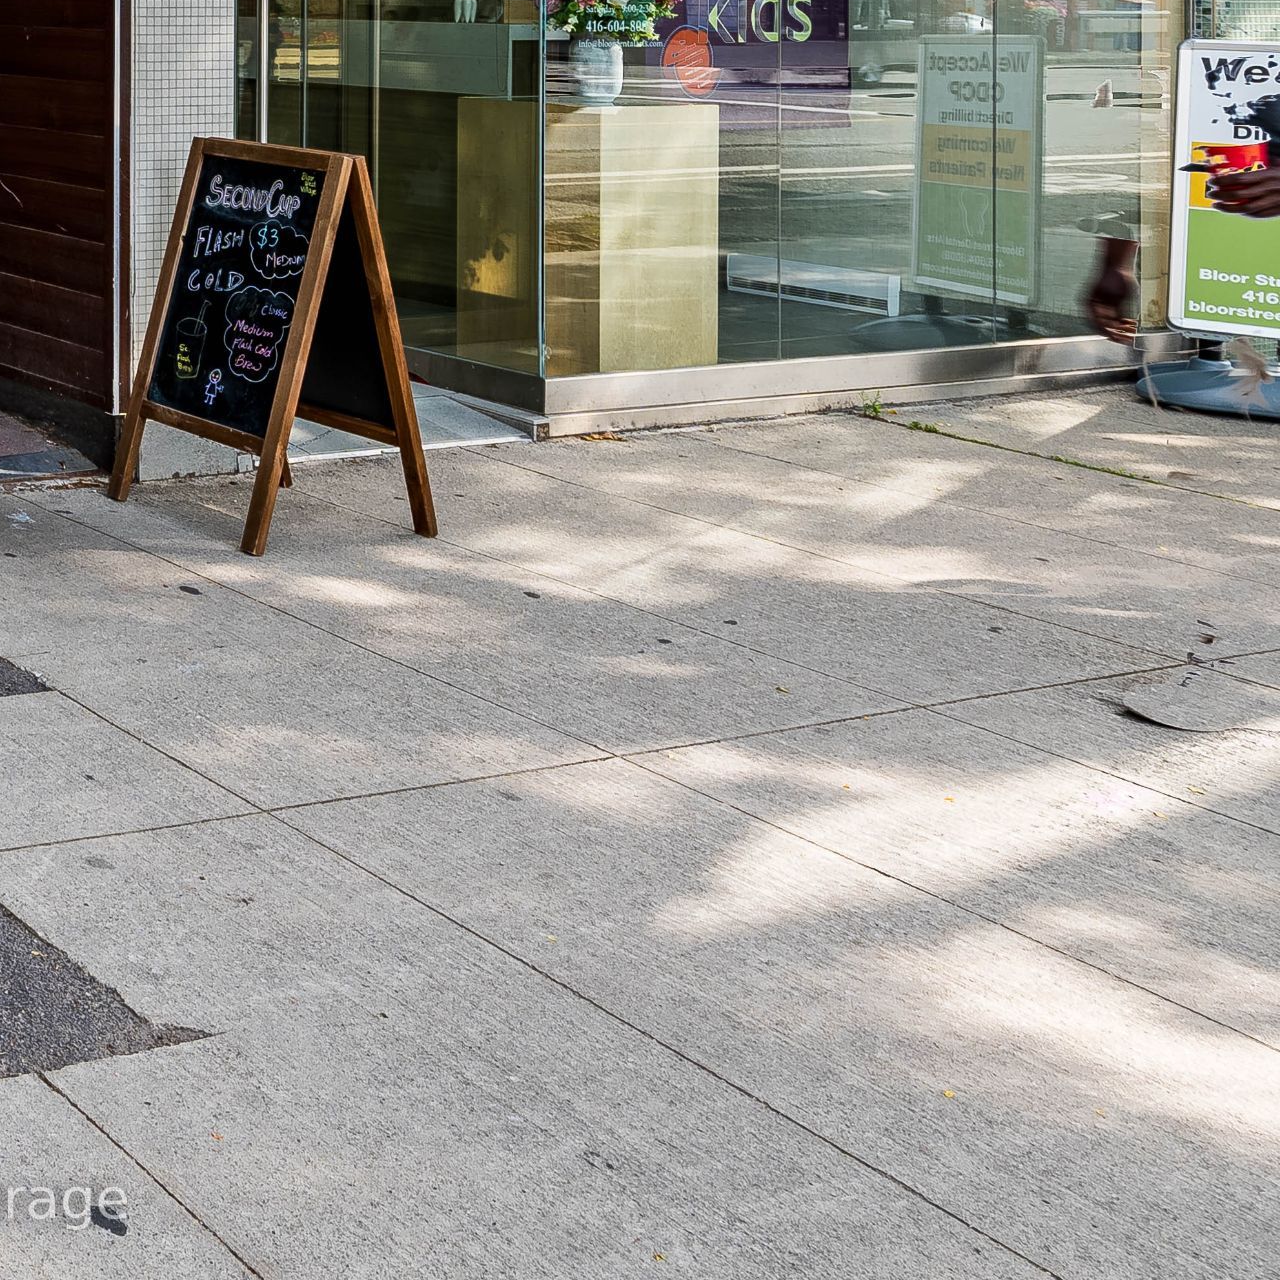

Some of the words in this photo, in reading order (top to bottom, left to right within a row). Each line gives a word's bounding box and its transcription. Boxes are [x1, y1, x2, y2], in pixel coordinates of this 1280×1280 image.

[586, 20, 649, 32] 416-604-80
[193, 225, 245, 257] FLASH
[257, 225, 279, 249] $3
[187, 268, 245, 292] COLD
[1199, 268, 1250, 284] Bloor
[233, 320, 274, 339] Medium
